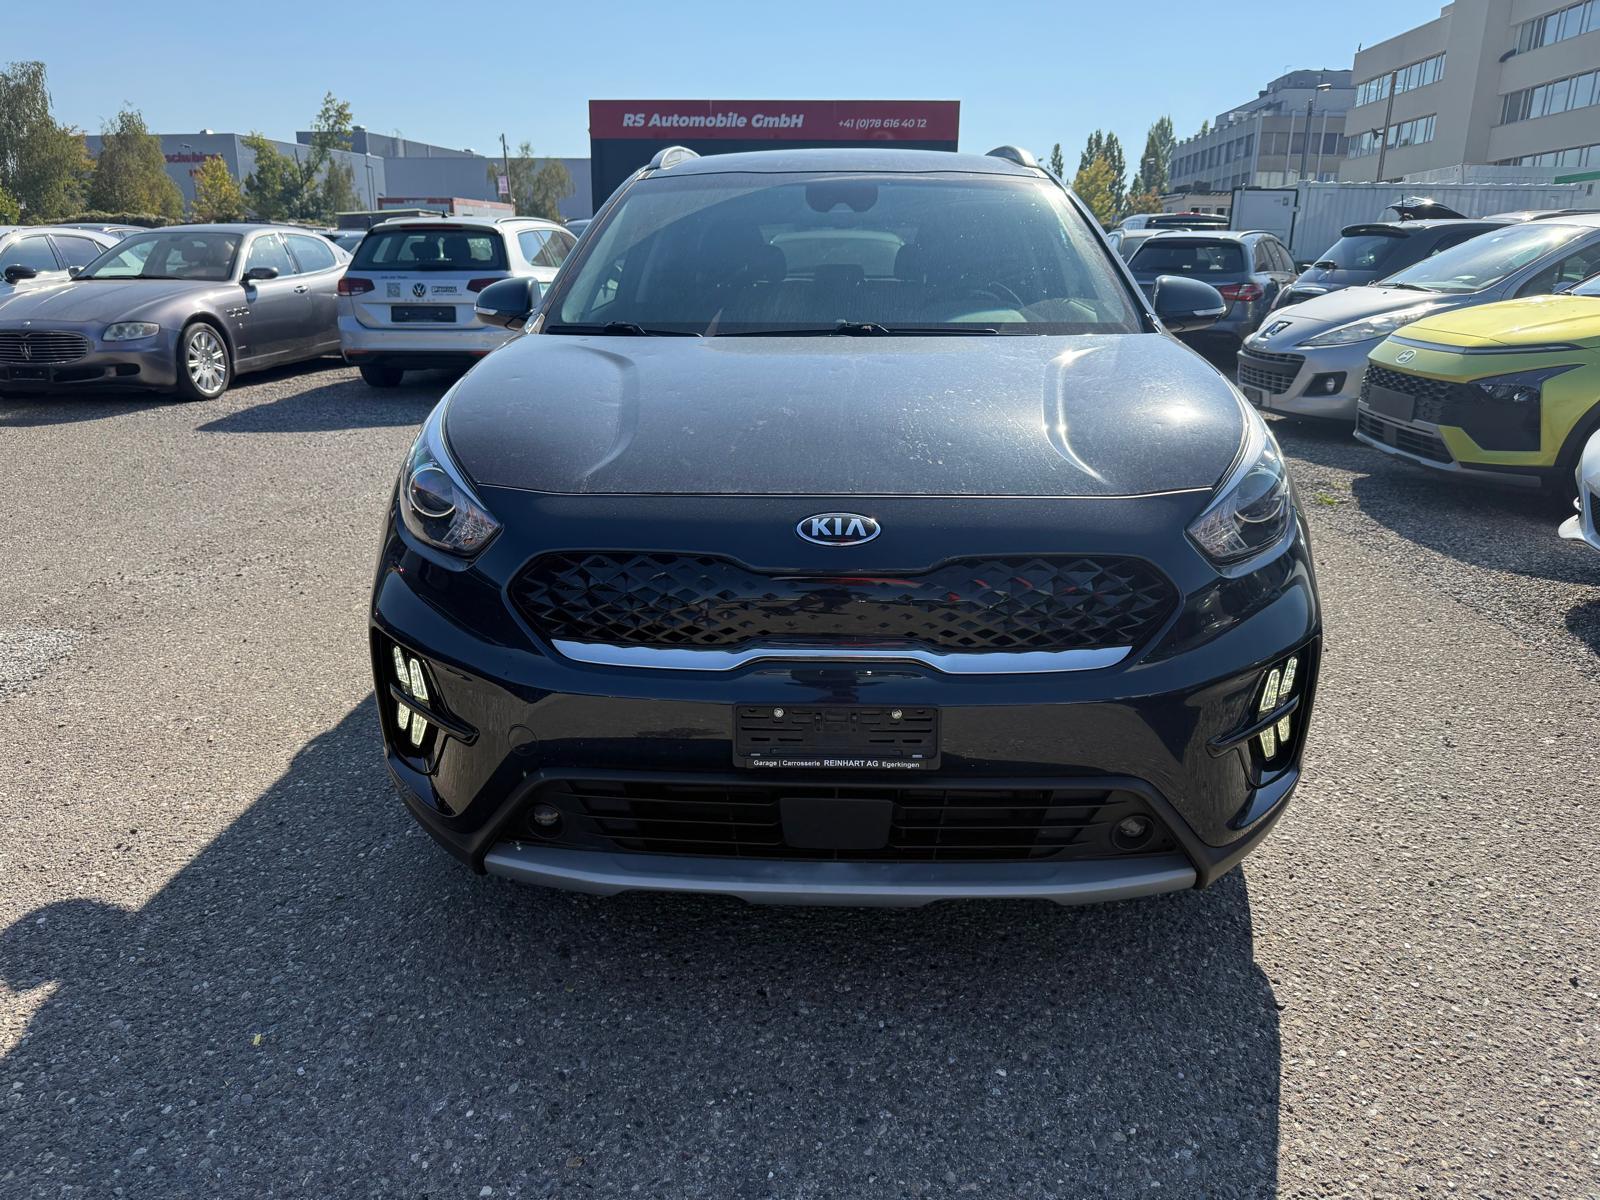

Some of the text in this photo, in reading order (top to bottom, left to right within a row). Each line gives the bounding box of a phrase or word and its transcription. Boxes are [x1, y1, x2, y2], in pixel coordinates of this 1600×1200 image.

[622, 112, 805, 128] RS Automobile GmbH
[838, 118, 927, 130] +41 (0)78 616 40 12
[811, 517, 867, 537] KIA
[753, 759, 777, 767] Garage
[823, 759, 865, 767] REINHART
[882, 761, 920, 769] Egerkingen
